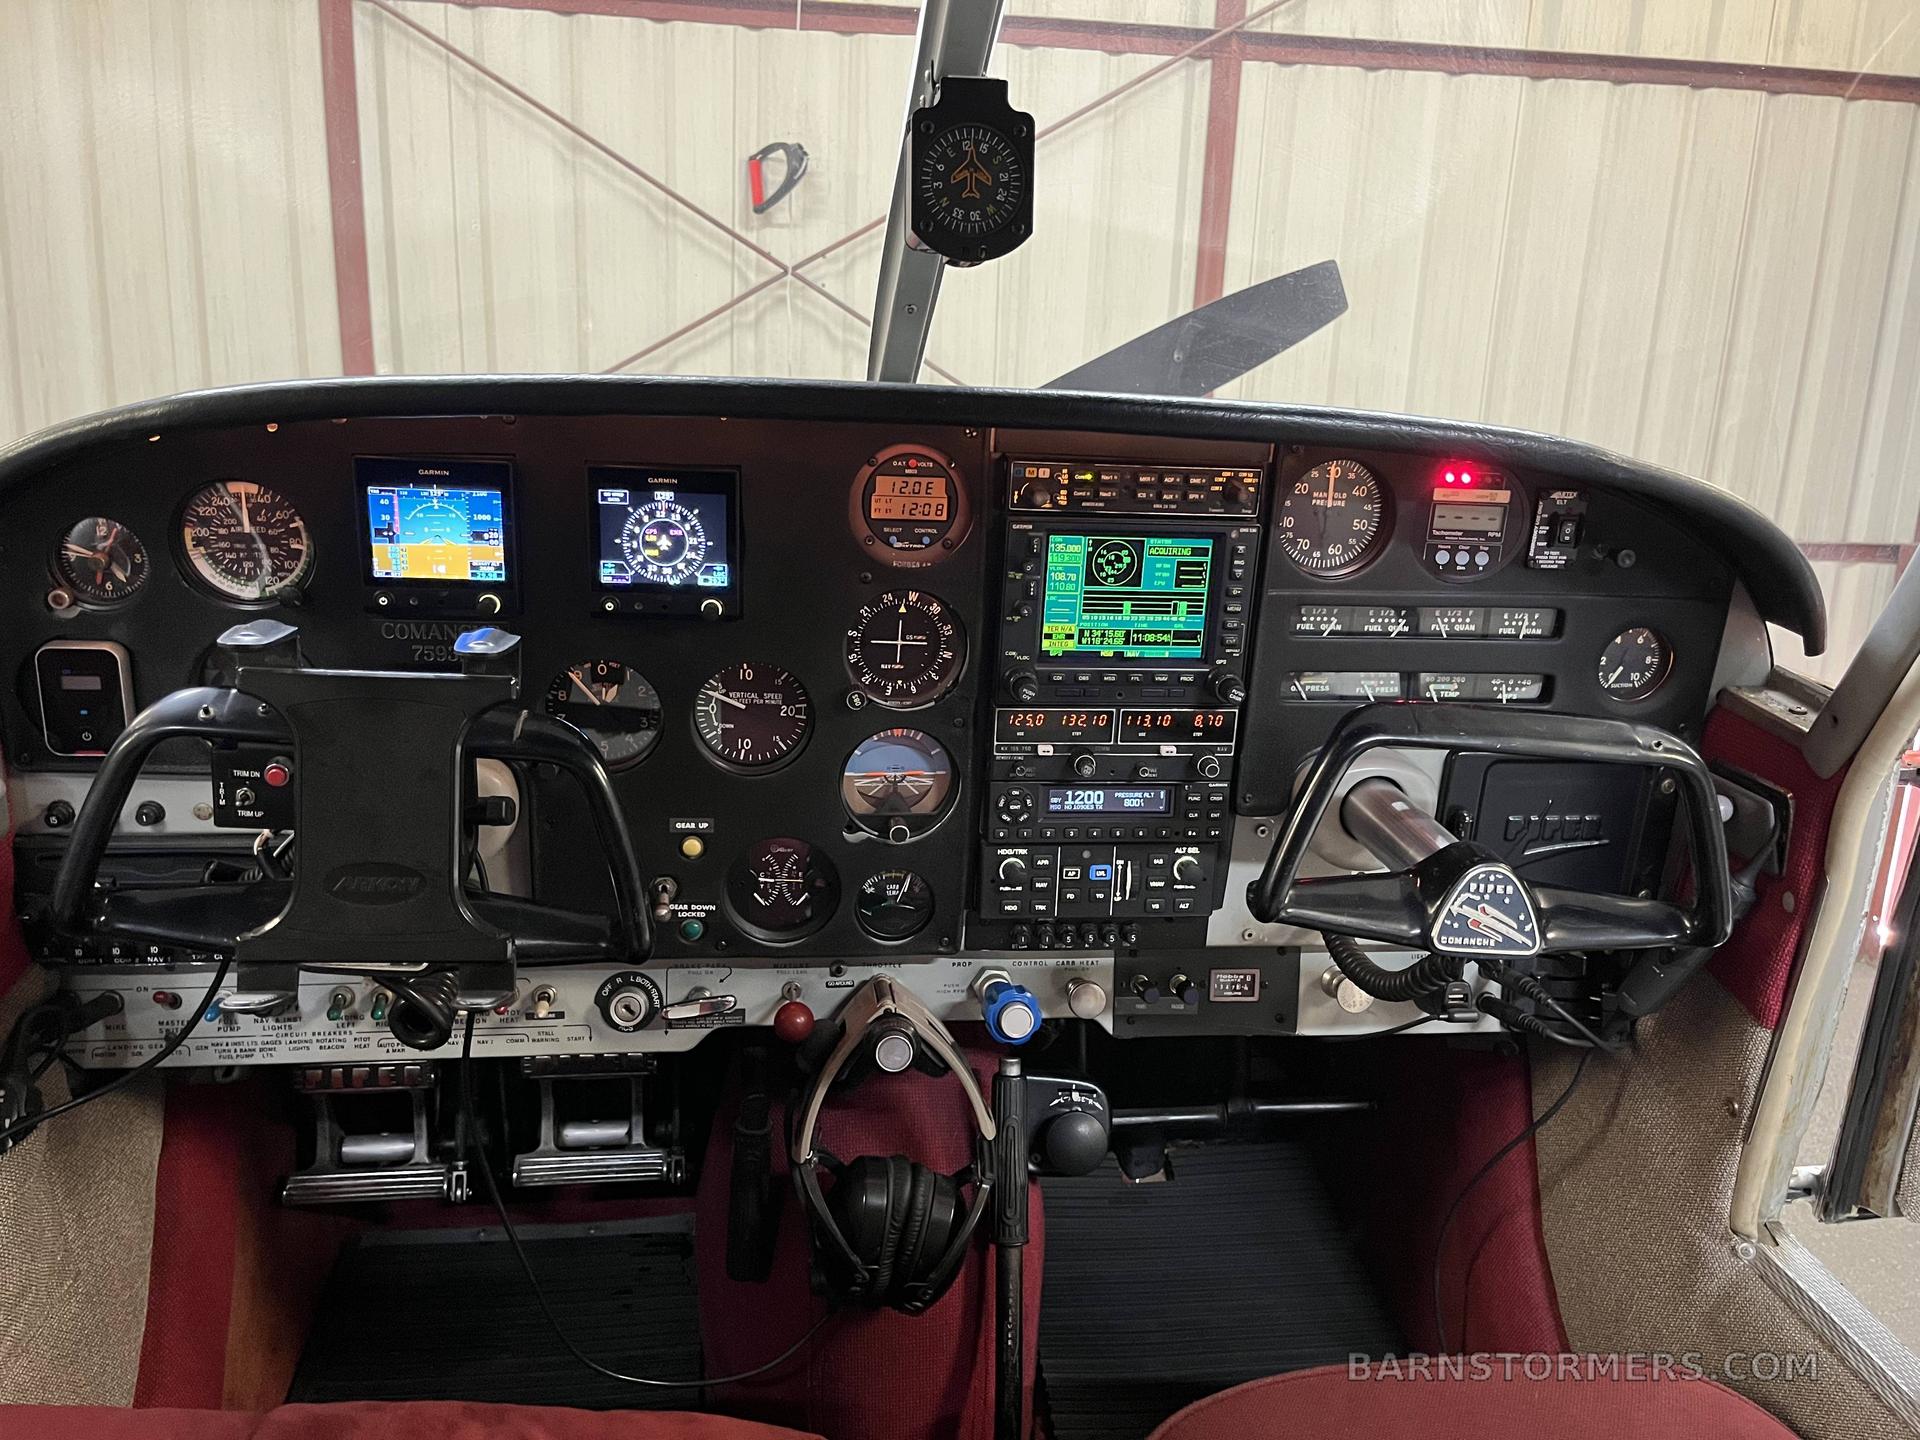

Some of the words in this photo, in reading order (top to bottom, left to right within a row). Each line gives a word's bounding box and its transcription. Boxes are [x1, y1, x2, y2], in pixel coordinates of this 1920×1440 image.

[962, 140, 970, 150] 12
[980, 143, 989, 154] 15
[999, 173, 1008, 182] 21
[996, 188, 1007, 201] 24
[953, 207, 964, 219] 33
[970, 211, 981, 221] 30
[1294, 483, 1309, 494] 20
[1352, 486, 1367, 496] 40
[211, 498, 230, 506] 240
[257, 495, 271, 503] 40
[200, 507, 217, 516] 220
[276, 511, 289, 519] 60
[901, 503, 944, 517] 12:08
[1283, 517, 1294, 527] 10
[1352, 520, 1367, 530] 50
[95, 526, 108, 536] 12
[192, 528, 210, 536] 200
[1297, 539, 1310, 550] 70
[1328, 544, 1342, 555] 60
[1149, 548, 1192, 556] ACQUIRING
[265, 576, 279, 585] 120
[882, 593, 893, 602] 24
[908, 591, 919, 601] W
[860, 605, 871, 616] 21
[929, 603, 941, 614] 30
[943, 624, 952, 635] 33
[848, 654, 858, 663] 15
[1600, 657, 1606, 665] 2
[598, 664, 607, 675] 0
[740, 669, 753, 680] 10
[861, 674, 872, 684] 12
[780, 705, 795, 716] 20
[1061, 714, 1107, 727] 132.10
[1126, 714, 1172, 728] 113.10
[1194, 715, 1224, 727] 8.70
[739, 738, 751, 749] 10
[1064, 791, 1104, 805] 1200
[1469, 882, 1514, 895] PIPER
[1441, 936, 1496, 947] COMANCHE
[636, 977, 653, 990] BOTH
[601, 983, 613, 996] OFF
[650, 989, 660, 1008] START
